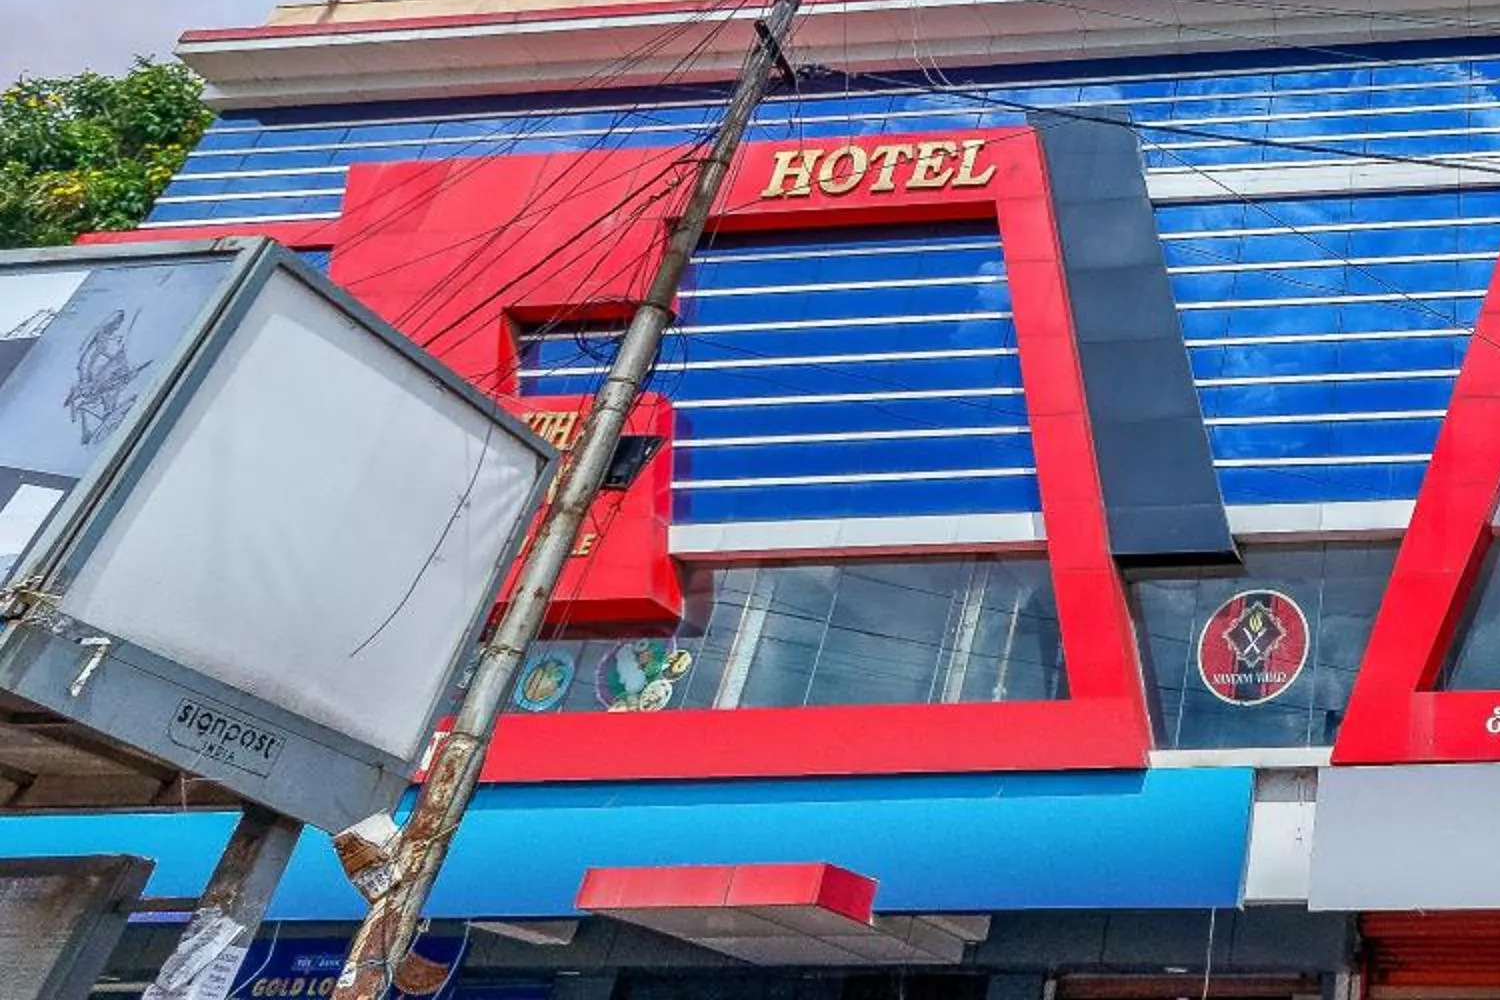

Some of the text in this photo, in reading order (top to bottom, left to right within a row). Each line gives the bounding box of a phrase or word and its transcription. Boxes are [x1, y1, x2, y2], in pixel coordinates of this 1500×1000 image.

[761, 139, 997, 200] HOTEL
[177, 704, 276, 760] signpost
[252, 976, 306, 997] GOLD
[307, 976, 338, 997] LO
